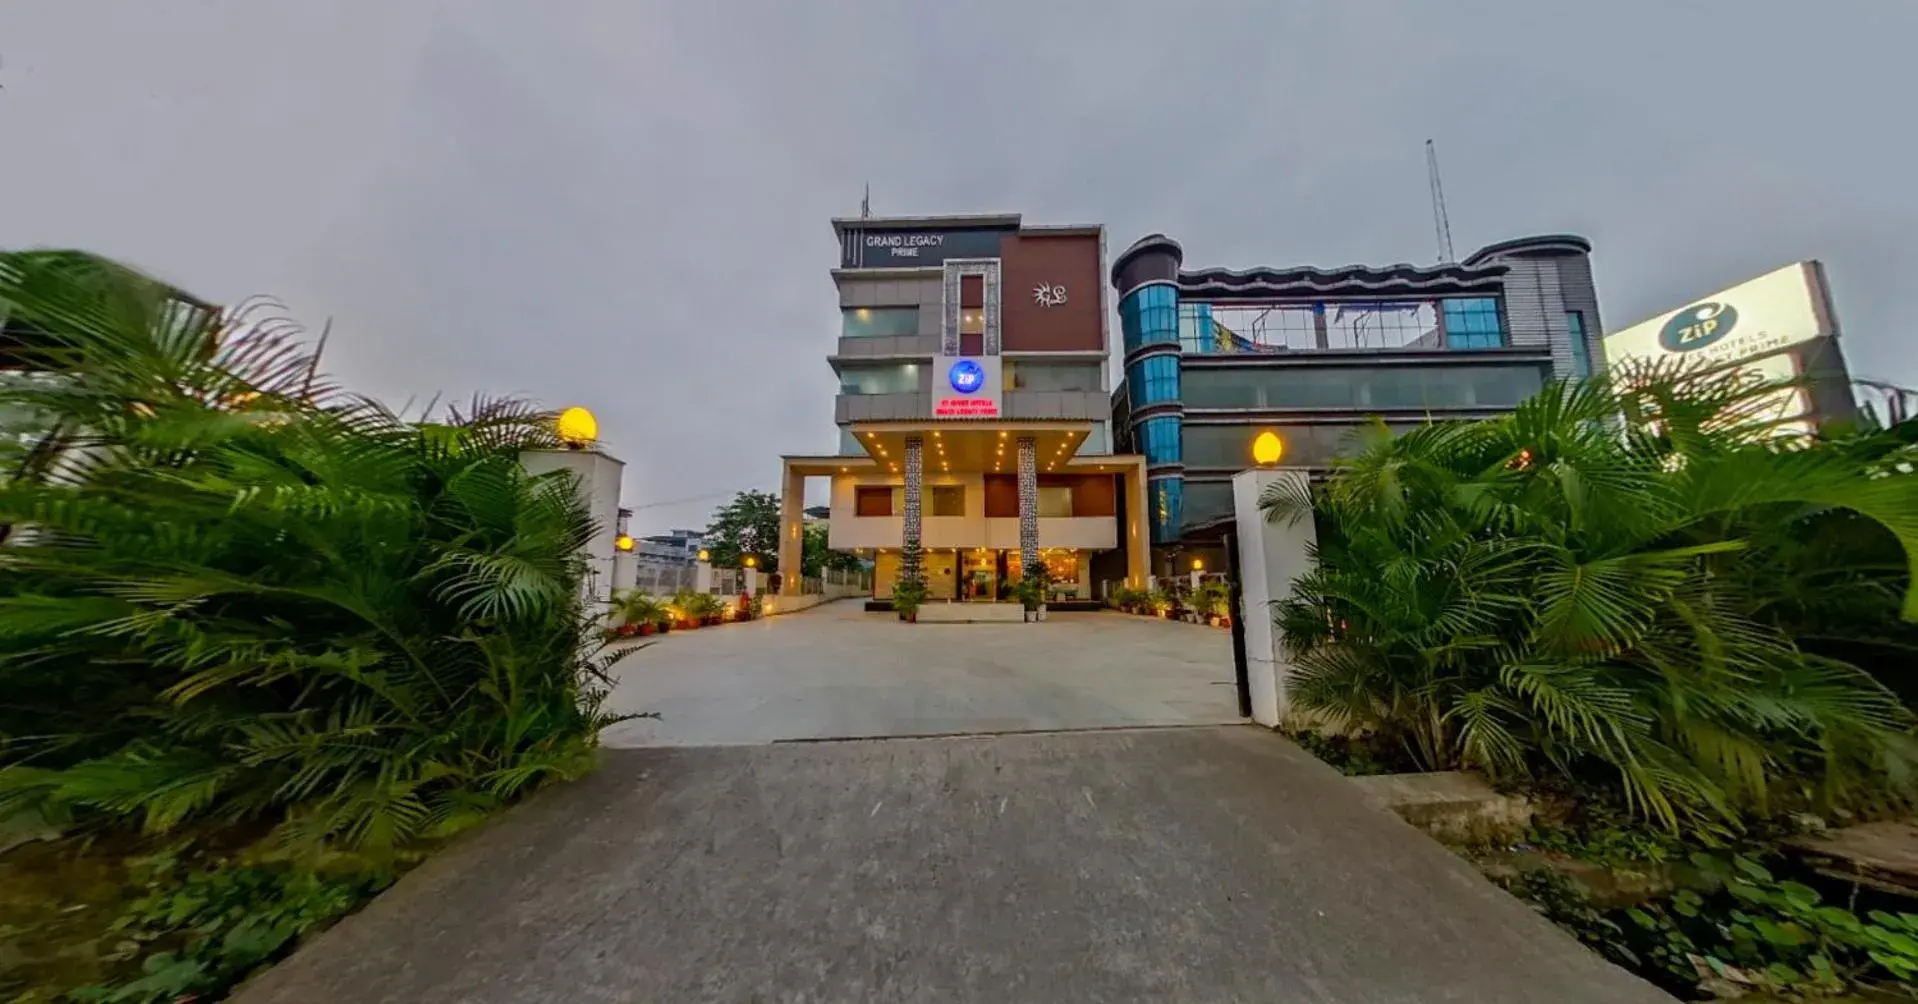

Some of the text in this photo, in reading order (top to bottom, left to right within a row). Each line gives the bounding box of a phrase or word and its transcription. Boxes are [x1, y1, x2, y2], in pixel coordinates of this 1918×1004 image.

[866, 235, 944, 247] GRAND LEGACY
[891, 247, 919, 256] PRIME
[1709, 330, 1768, 353] HOTELS
[1740, 335, 1789, 355] PRIME
